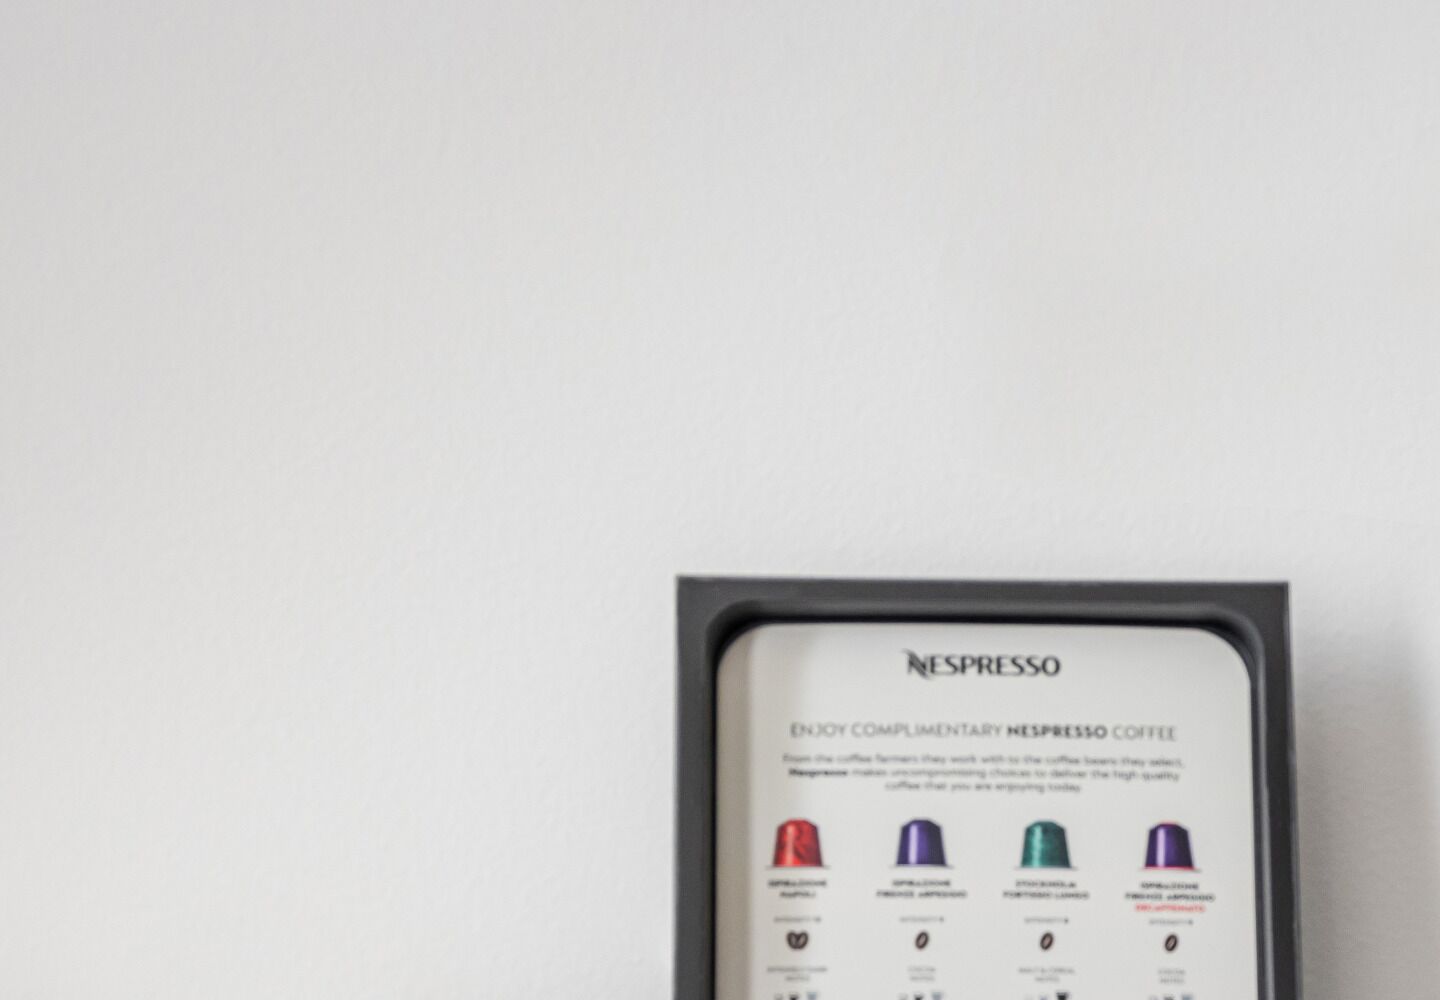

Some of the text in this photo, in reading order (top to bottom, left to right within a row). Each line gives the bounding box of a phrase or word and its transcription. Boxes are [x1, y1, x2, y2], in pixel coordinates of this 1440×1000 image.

[903, 651, 1061, 679] NESPRESSO
[789, 721, 1175, 741] ENJOY COMPLIMENTARY NESPRESSO COFFEE
